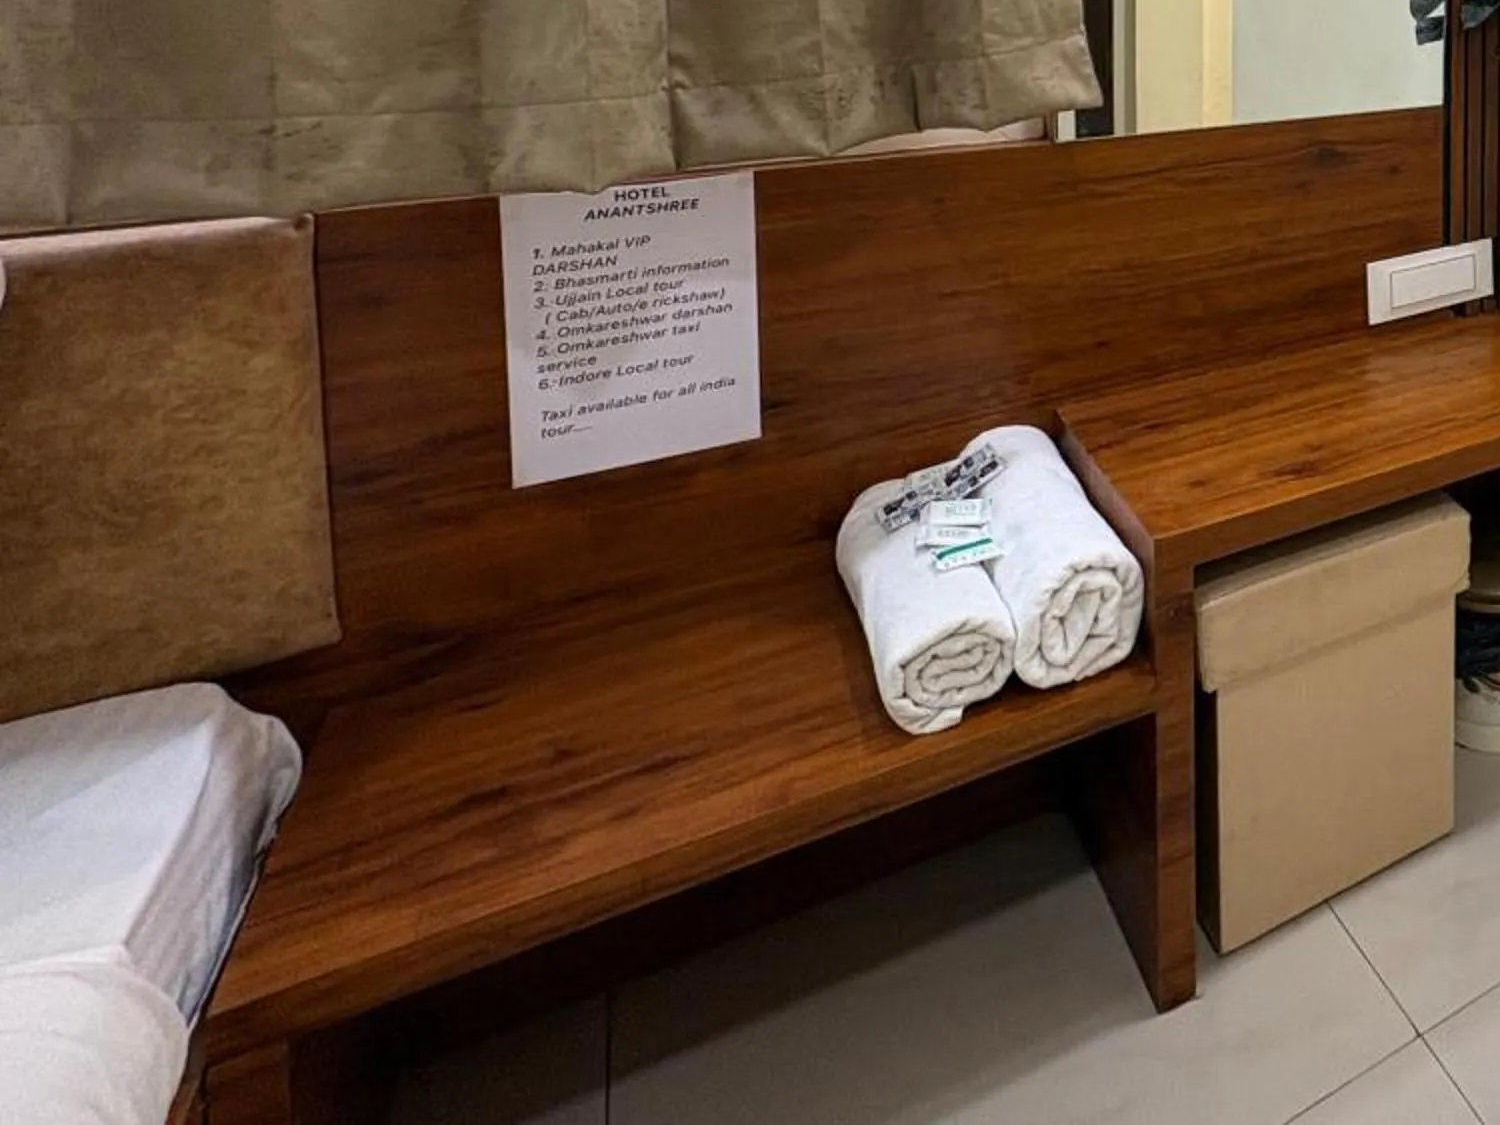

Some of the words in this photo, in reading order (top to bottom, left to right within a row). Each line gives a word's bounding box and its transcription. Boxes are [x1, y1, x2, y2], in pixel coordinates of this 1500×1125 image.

[613, 186, 671, 202] HOTEL
[584, 199, 700, 220] ANANTSHREE
[532, 248, 544, 260] 1.
[551, 238, 620, 258] Mahakal
[533, 255, 618, 276] DARSHAN
[533, 280, 547, 293] 2.
[554, 268, 639, 291] Bhasmarti
[641, 256, 730, 276] information
[533, 296, 548, 310] 3.
[555, 290, 602, 308] Ujjain
[605, 283, 649, 300] Local
[652, 279, 686, 291] tour
[651, 287, 726, 308] rickshaw)
[535, 329, 549, 340] 4.
[557, 313, 667, 339] Omkareshwar
[671, 302, 733, 320] darshan
[557, 329, 667, 354] Omkareshwar
[671, 323, 701, 335] taxi
[537, 355, 598, 374] service
[616, 360, 659, 376] Local
[663, 354, 695, 368] tour
[541, 406, 573, 422] Taxi
[577, 394, 648, 415] available
[652, 386, 673, 402] for
[678, 382, 696, 396] all
[700, 376, 736, 392] india
